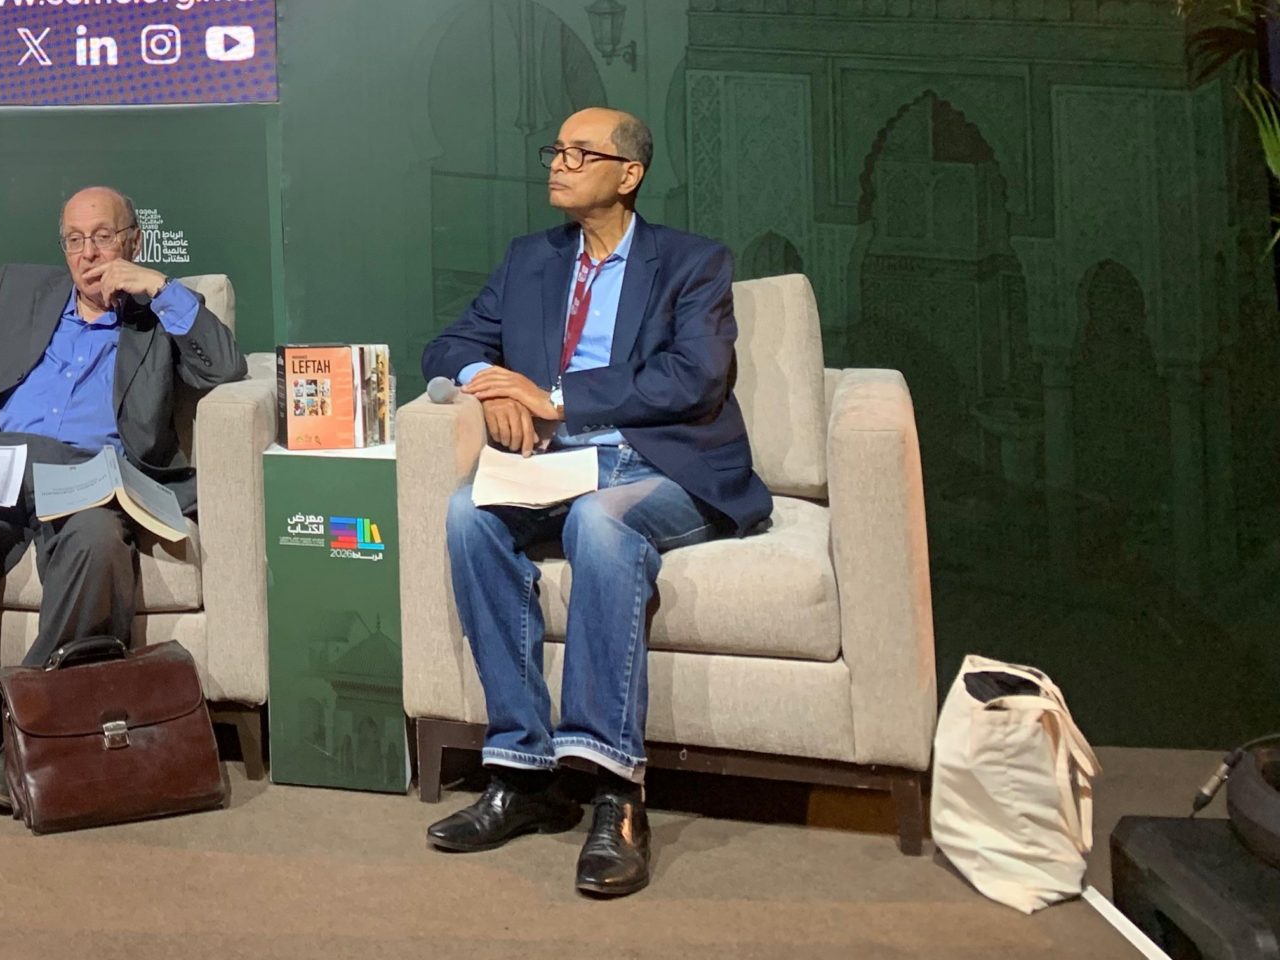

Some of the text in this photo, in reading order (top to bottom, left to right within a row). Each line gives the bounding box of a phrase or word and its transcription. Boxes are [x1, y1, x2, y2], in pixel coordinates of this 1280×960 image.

[292, 359, 331, 374] LEFTAH
[287, 512, 324, 524] معرض
[287, 523, 325, 535] الكتاب
